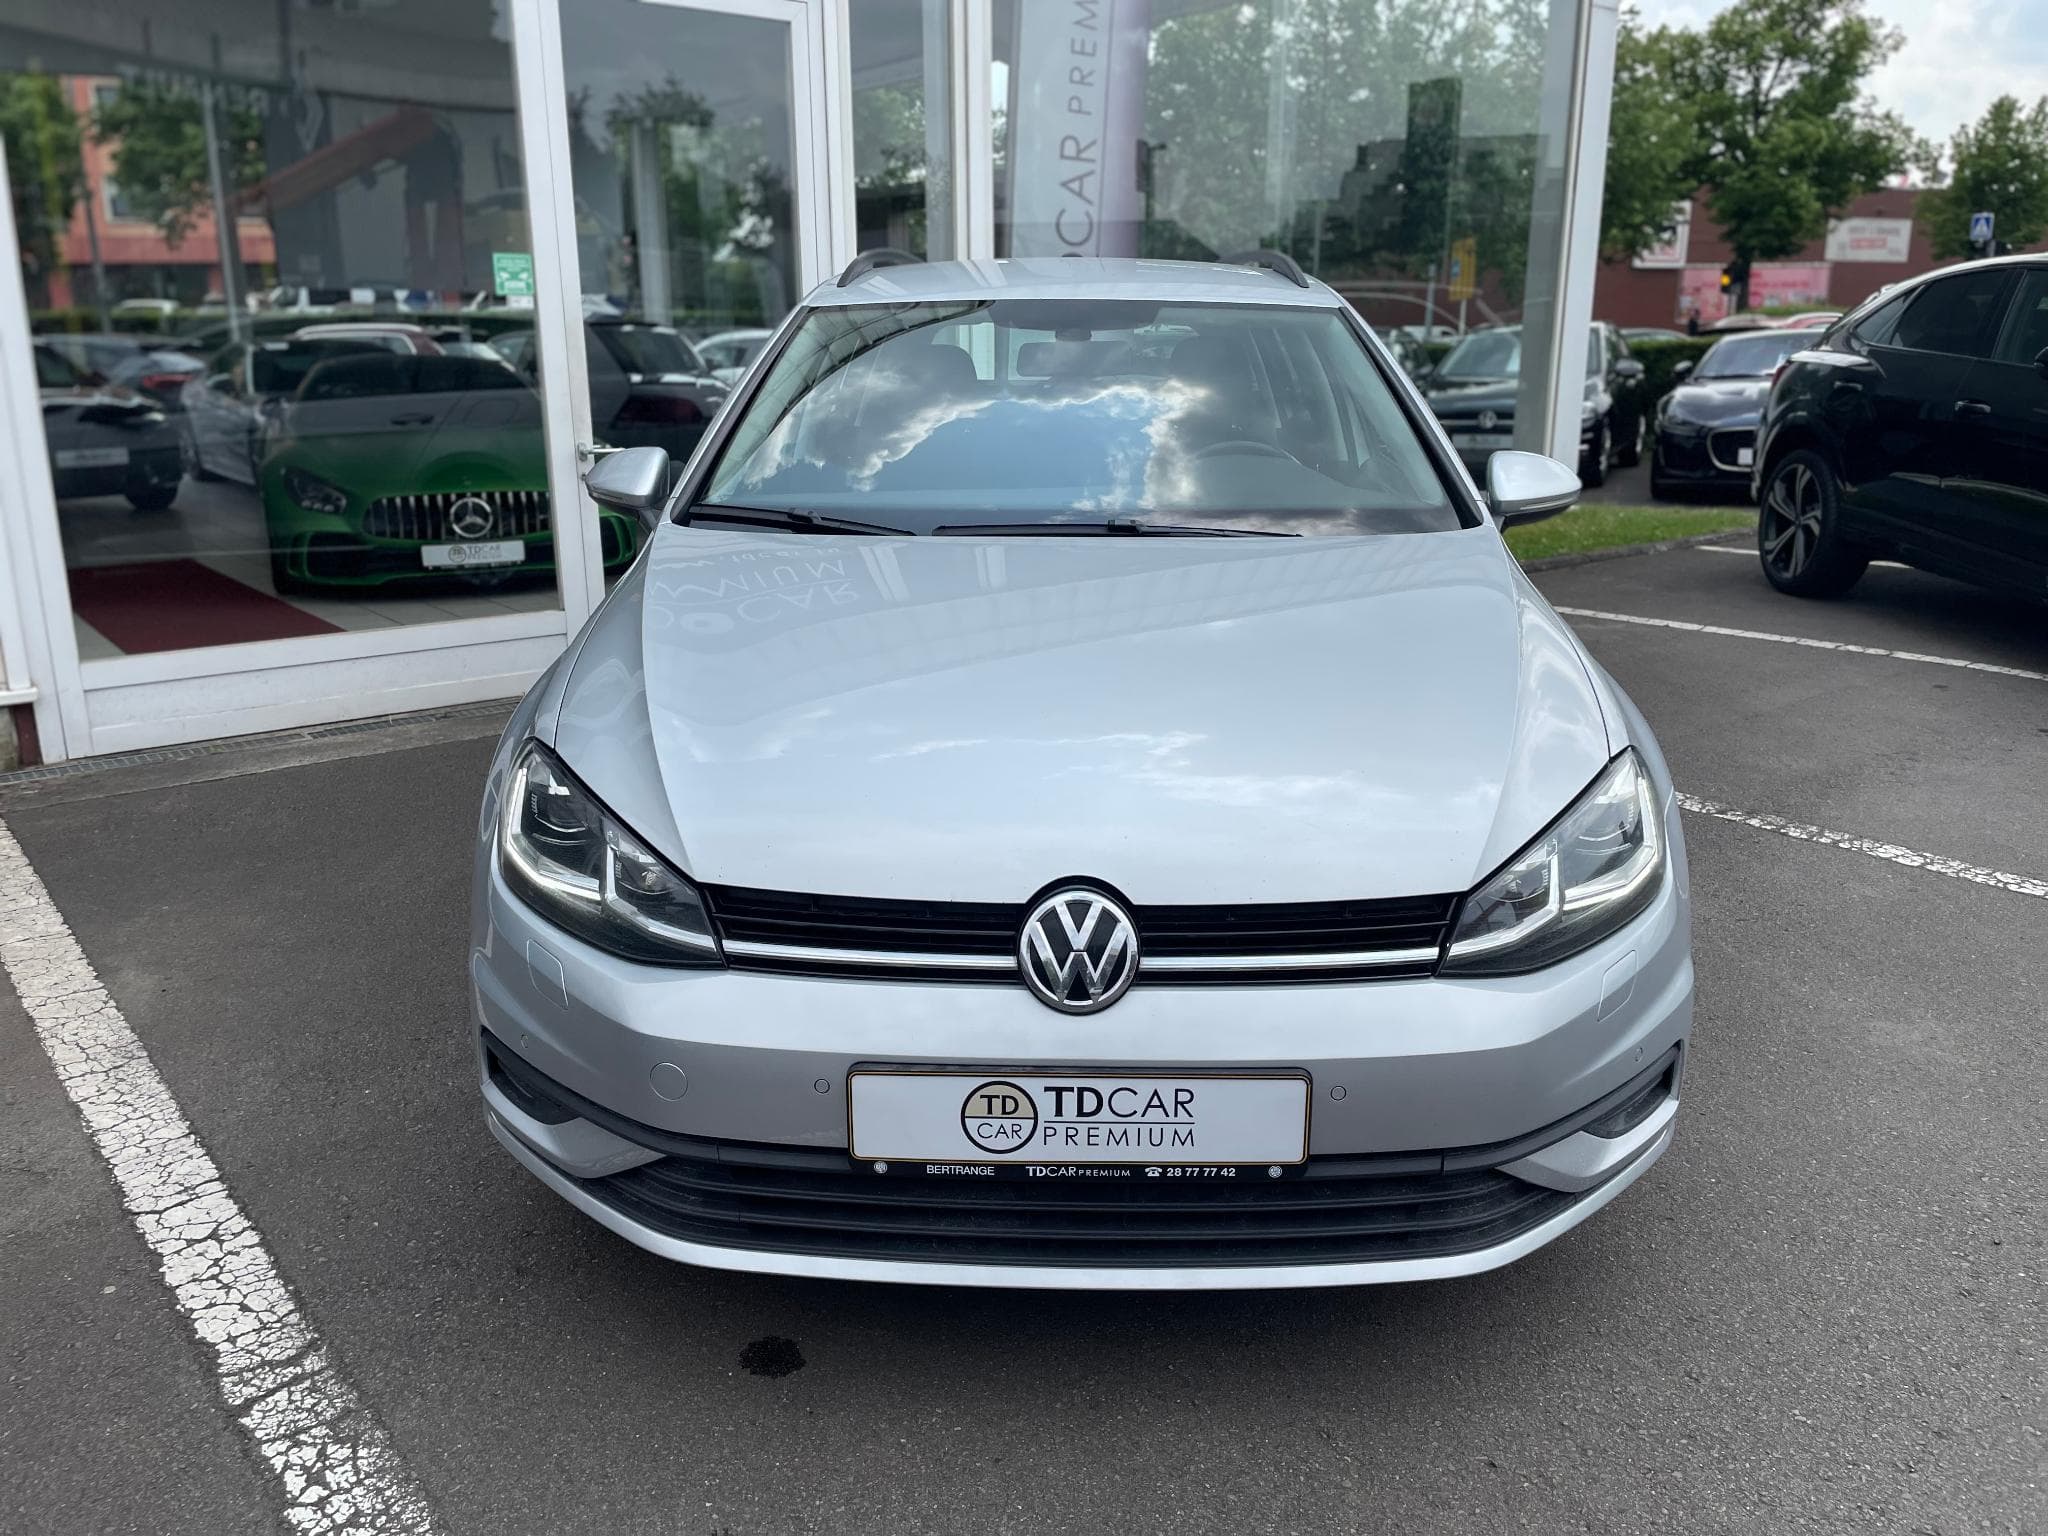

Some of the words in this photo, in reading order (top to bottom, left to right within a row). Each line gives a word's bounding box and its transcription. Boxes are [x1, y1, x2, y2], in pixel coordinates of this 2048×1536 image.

[1055, 134, 1098, 257] CAR
[979, 1094, 1019, 1116] TD
[1043, 1086, 1195, 1118] TDCAR
[977, 1122, 1022, 1140] CAR
[1043, 1126, 1195, 1147] PREMIUM
[926, 1164, 995, 1176] BERTRANGE
